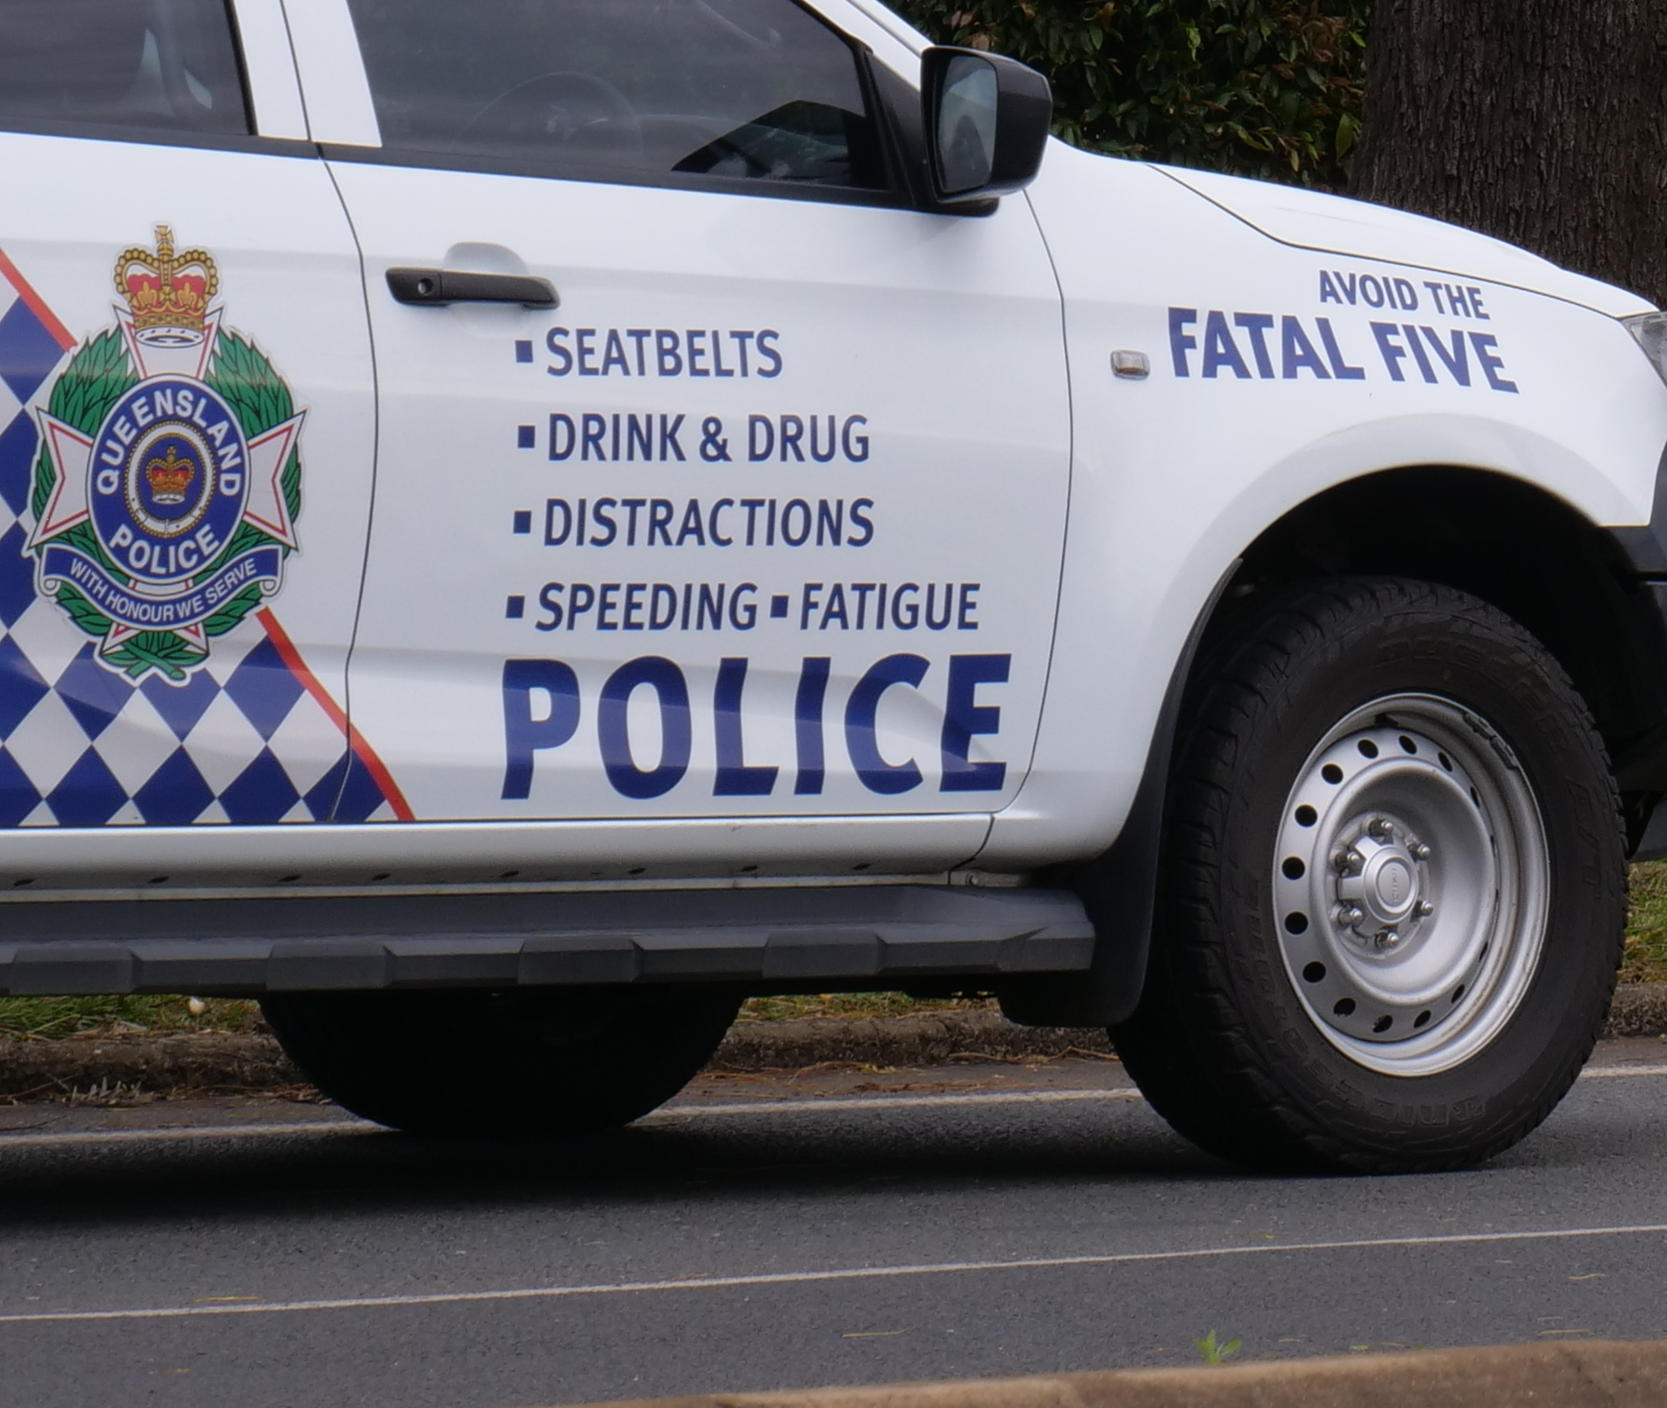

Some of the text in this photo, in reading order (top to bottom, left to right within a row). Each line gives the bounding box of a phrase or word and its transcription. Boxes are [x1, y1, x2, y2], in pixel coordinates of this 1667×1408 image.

[1320, 271, 1490, 320] AVOID THE
[546, 328, 784, 378] SEATBELTS
[1168, 307, 1519, 394] FATAL FIVE
[97, 389, 241, 495] QUEENSLAND
[548, 414, 870, 463] DRINK & DRUG
[543, 499, 875, 547] DISTRACTIONS
[109, 524, 220, 574] POLICE
[71, 557, 257, 622] WITH HONOUR WE SERVE
[534, 583, 982, 632] SPEEDING FATIGUE
[499, 653, 1012, 801] POLICE
